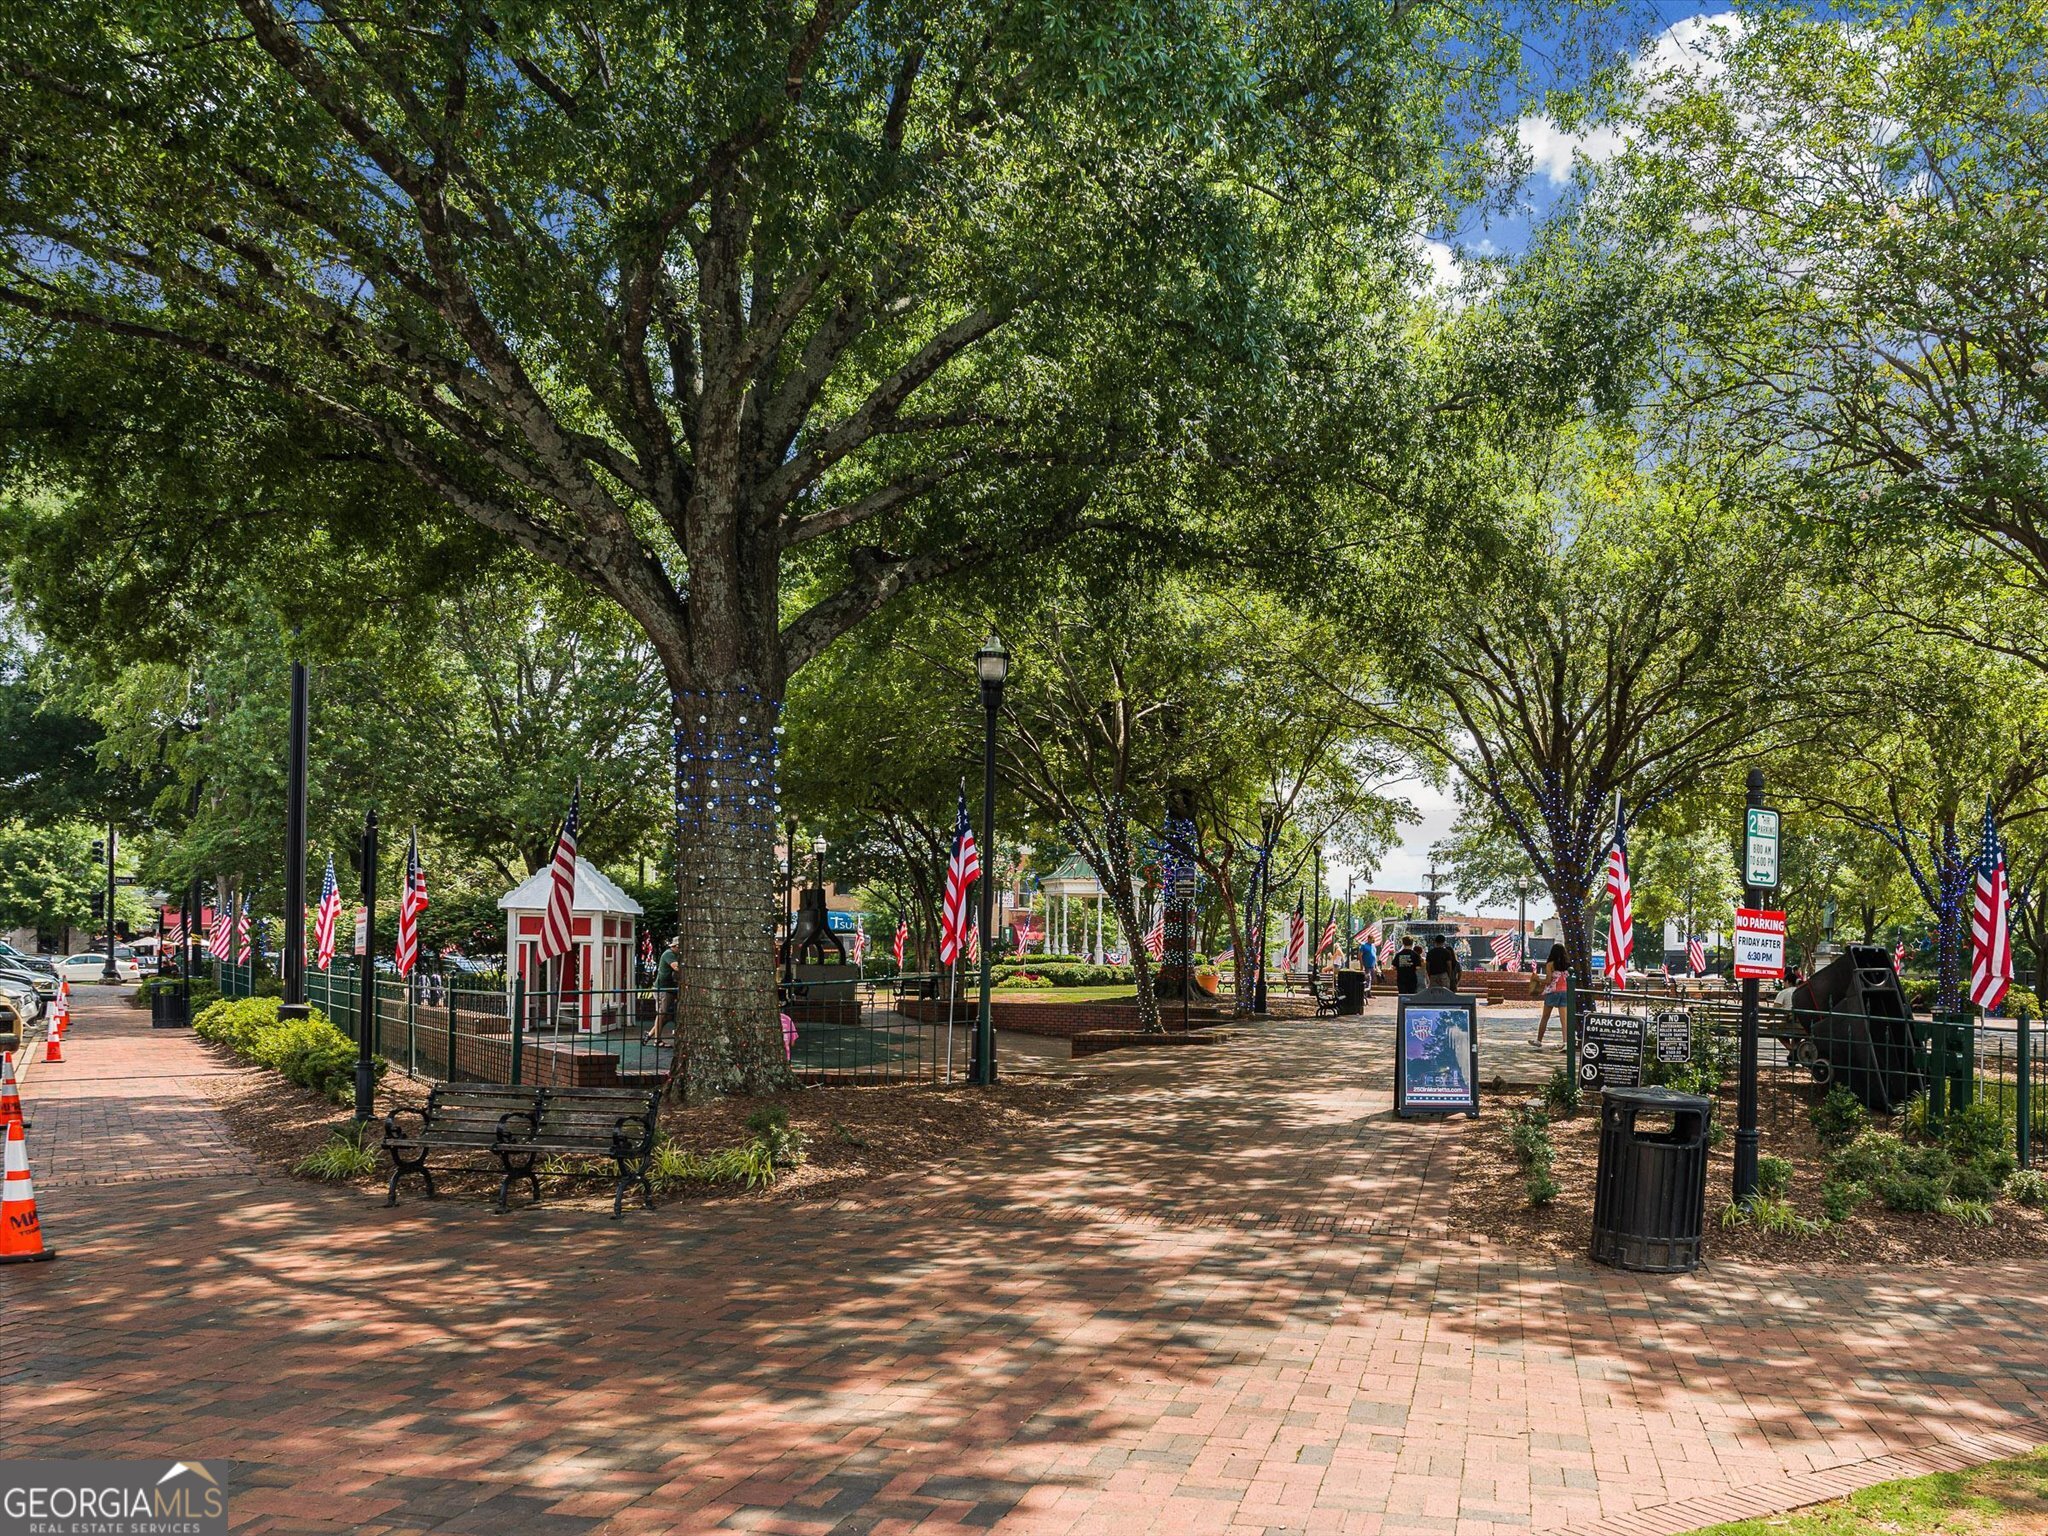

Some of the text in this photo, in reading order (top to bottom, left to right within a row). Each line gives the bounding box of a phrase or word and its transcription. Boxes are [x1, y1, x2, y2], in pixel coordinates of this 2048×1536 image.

[1750, 815, 1756, 832] 2
[1763, 816, 1770, 824] HR
[1758, 825, 1775, 836] PARKING
[1765, 846, 1772, 856] AM
[1750, 856, 1756, 866] TO
[1768, 858, 1774, 868] PM
[1736, 916, 1784, 932] NO PARKING
[1738, 936, 1781, 949] FRIDAY AFTER
[1747, 952, 1772, 962] 6:30 PM
[1590, 1017, 1639, 1029] PARK OPEN
[1668, 1014, 1680, 1022] NO
